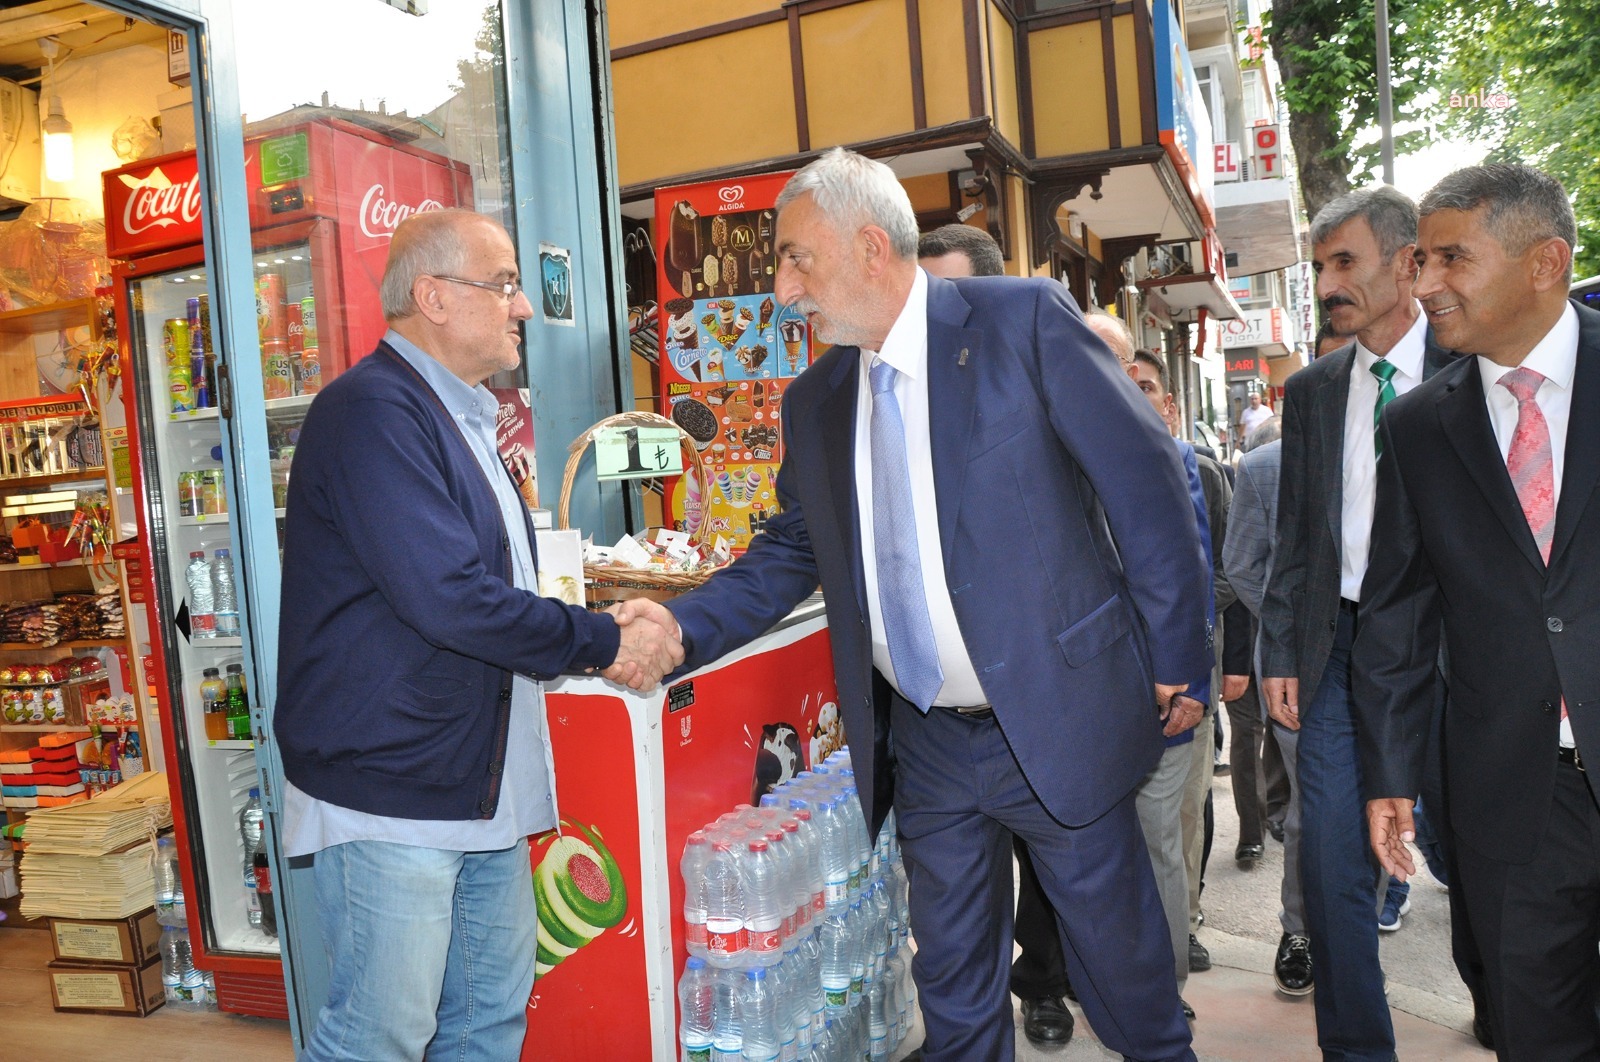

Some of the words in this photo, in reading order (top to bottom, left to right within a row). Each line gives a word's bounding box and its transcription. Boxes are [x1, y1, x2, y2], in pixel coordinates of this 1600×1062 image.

[1257, 130, 1276, 179] OT
[123, 172, 201, 235] Coca-C
[675, 348, 708, 372] Cornetto
[670, 383, 691, 395] NOGGER
[616, 428, 653, 473] 1
